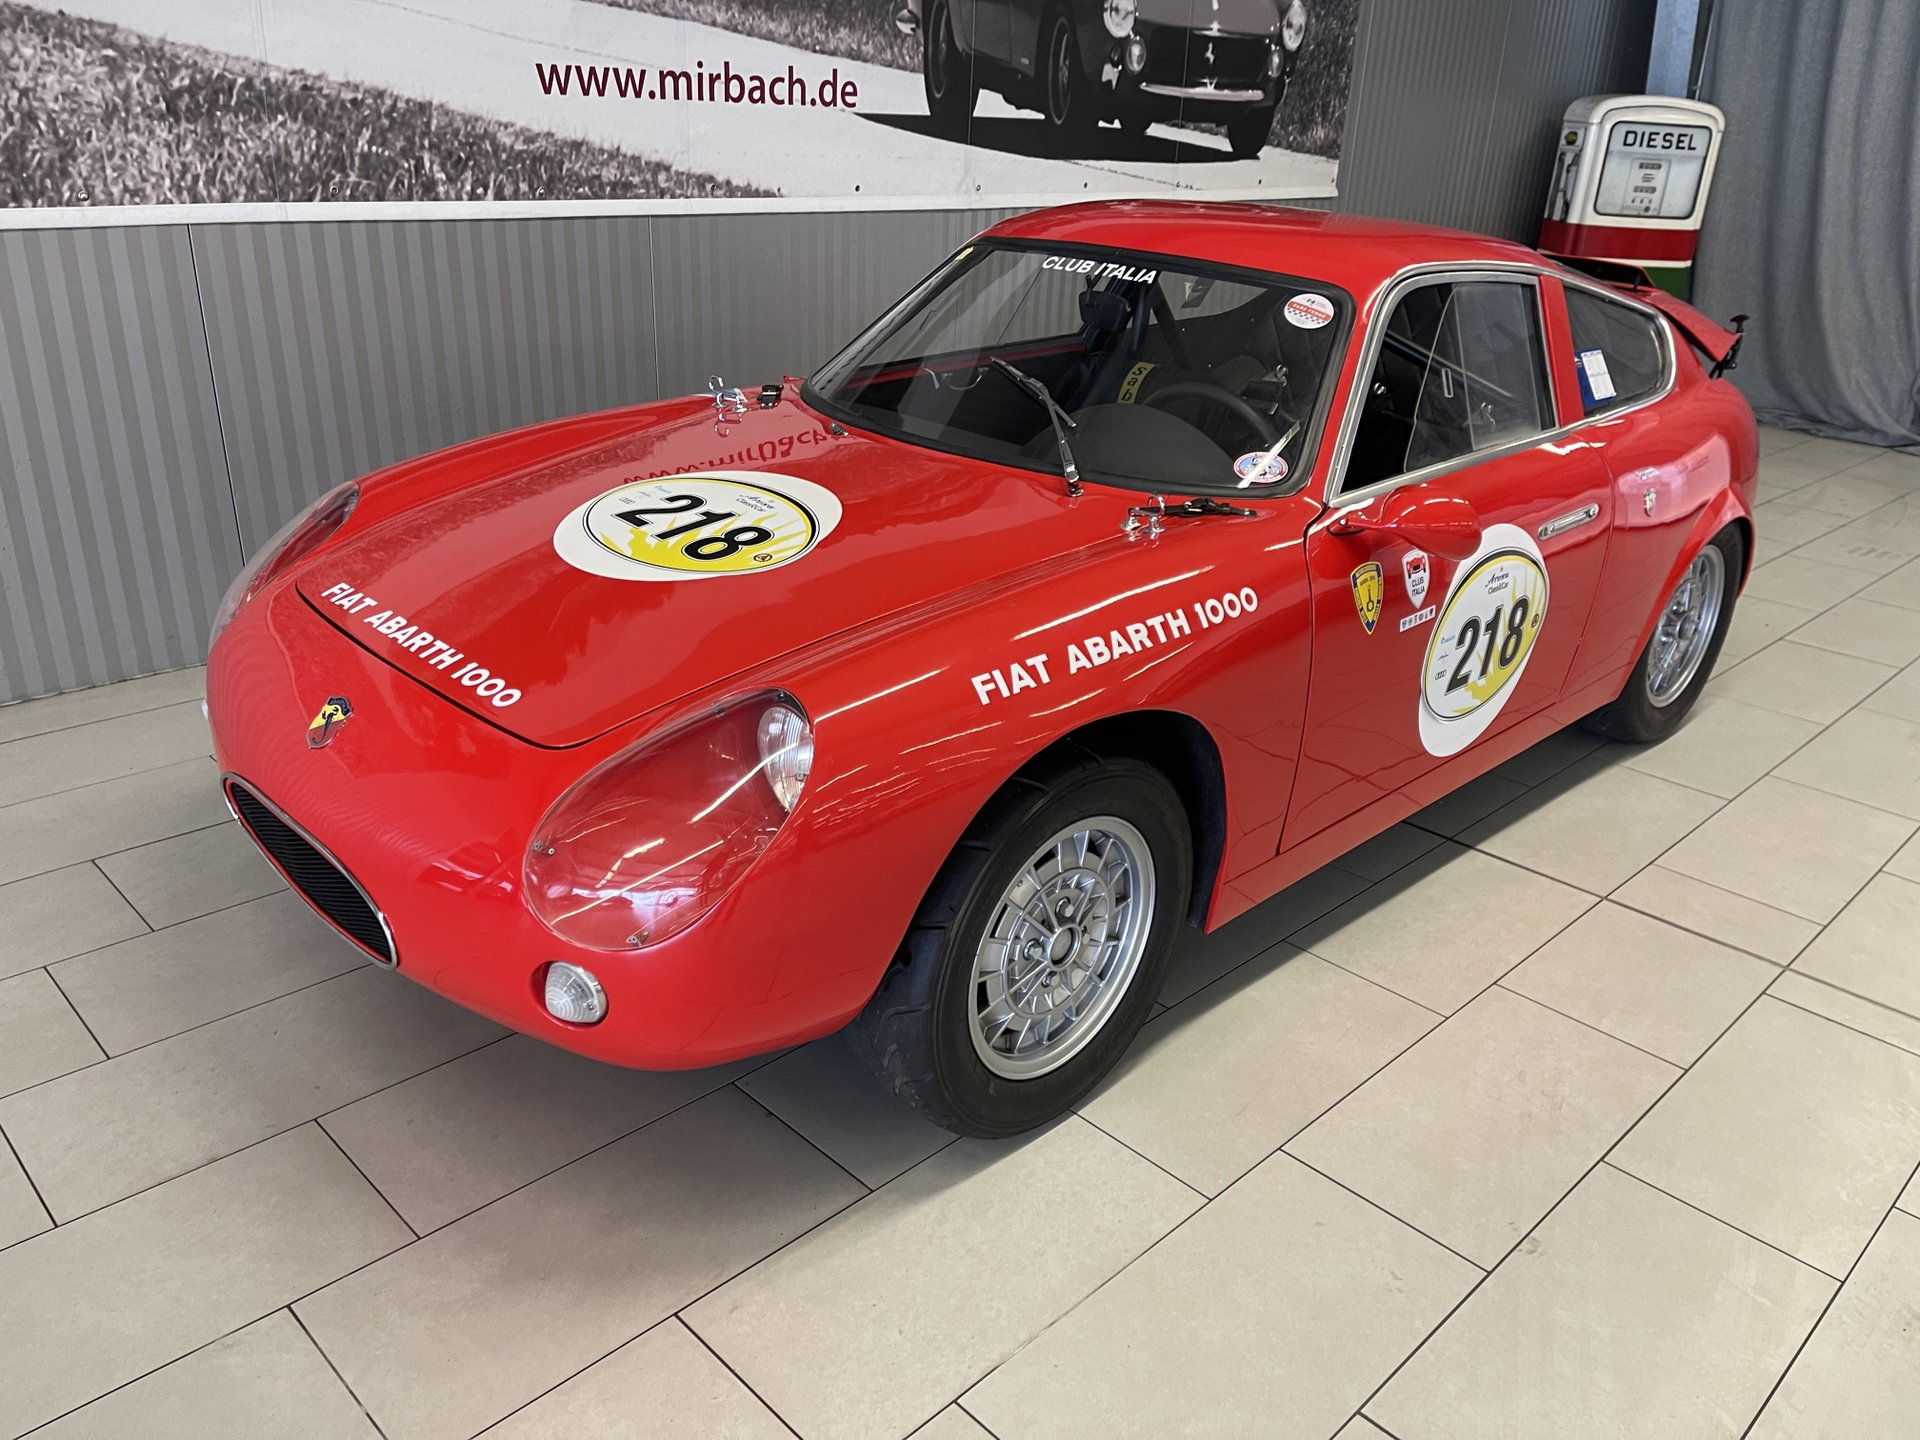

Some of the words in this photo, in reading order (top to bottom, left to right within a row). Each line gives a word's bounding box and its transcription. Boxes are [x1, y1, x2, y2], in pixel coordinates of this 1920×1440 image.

[535, 60, 859, 108] www.mirbach.de
[1622, 130, 1697, 151] DIESEL
[1041, 255, 1095, 274] CLUB
[1093, 262, 1158, 284] ITALIA
[611, 494, 775, 561] 218
[1411, 576, 1424, 587] CLUB
[1411, 587, 1426, 597] ITALIA
[320, 582, 378, 614] FIAT
[363, 610, 464, 670] ABARTH
[450, 662, 522, 707] 1000
[971, 653, 1051, 706] FIAT
[1068, 608, 1192, 675] ABARTH
[1193, 586, 1259, 629] 1000
[1444, 595, 1531, 696] 218
